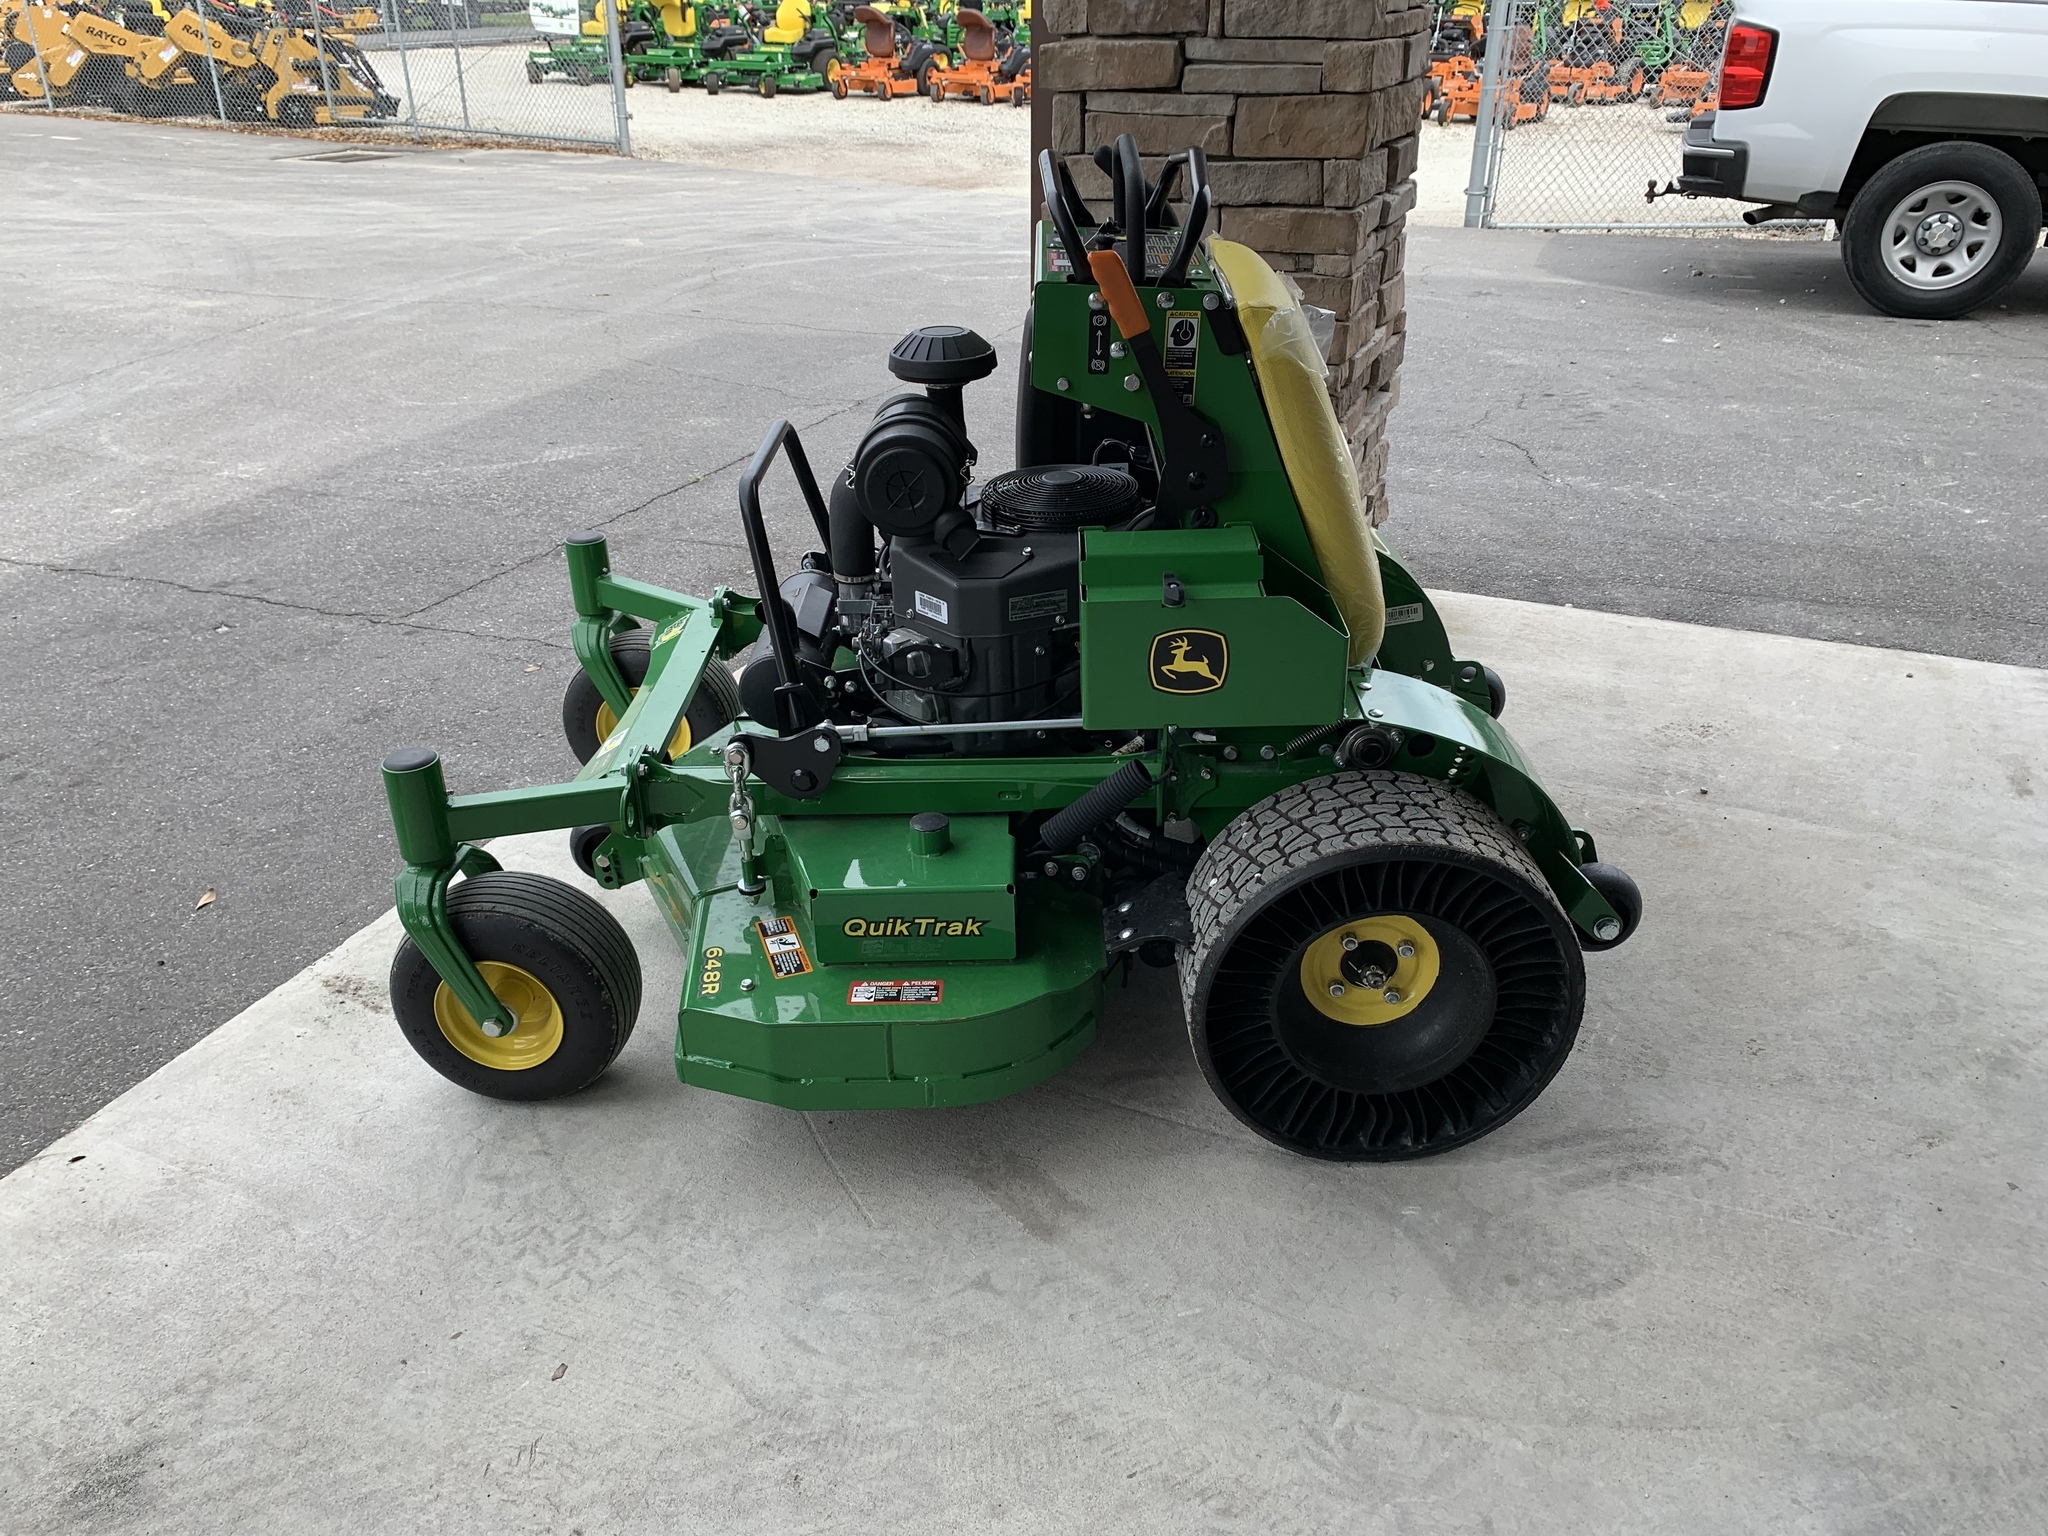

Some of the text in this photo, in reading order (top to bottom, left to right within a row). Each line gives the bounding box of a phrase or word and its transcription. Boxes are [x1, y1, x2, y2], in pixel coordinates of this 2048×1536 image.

[86, 26, 127, 46] RAYCO
[843, 917, 984, 937] QuikTrak
[701, 946, 724, 996] 648R
